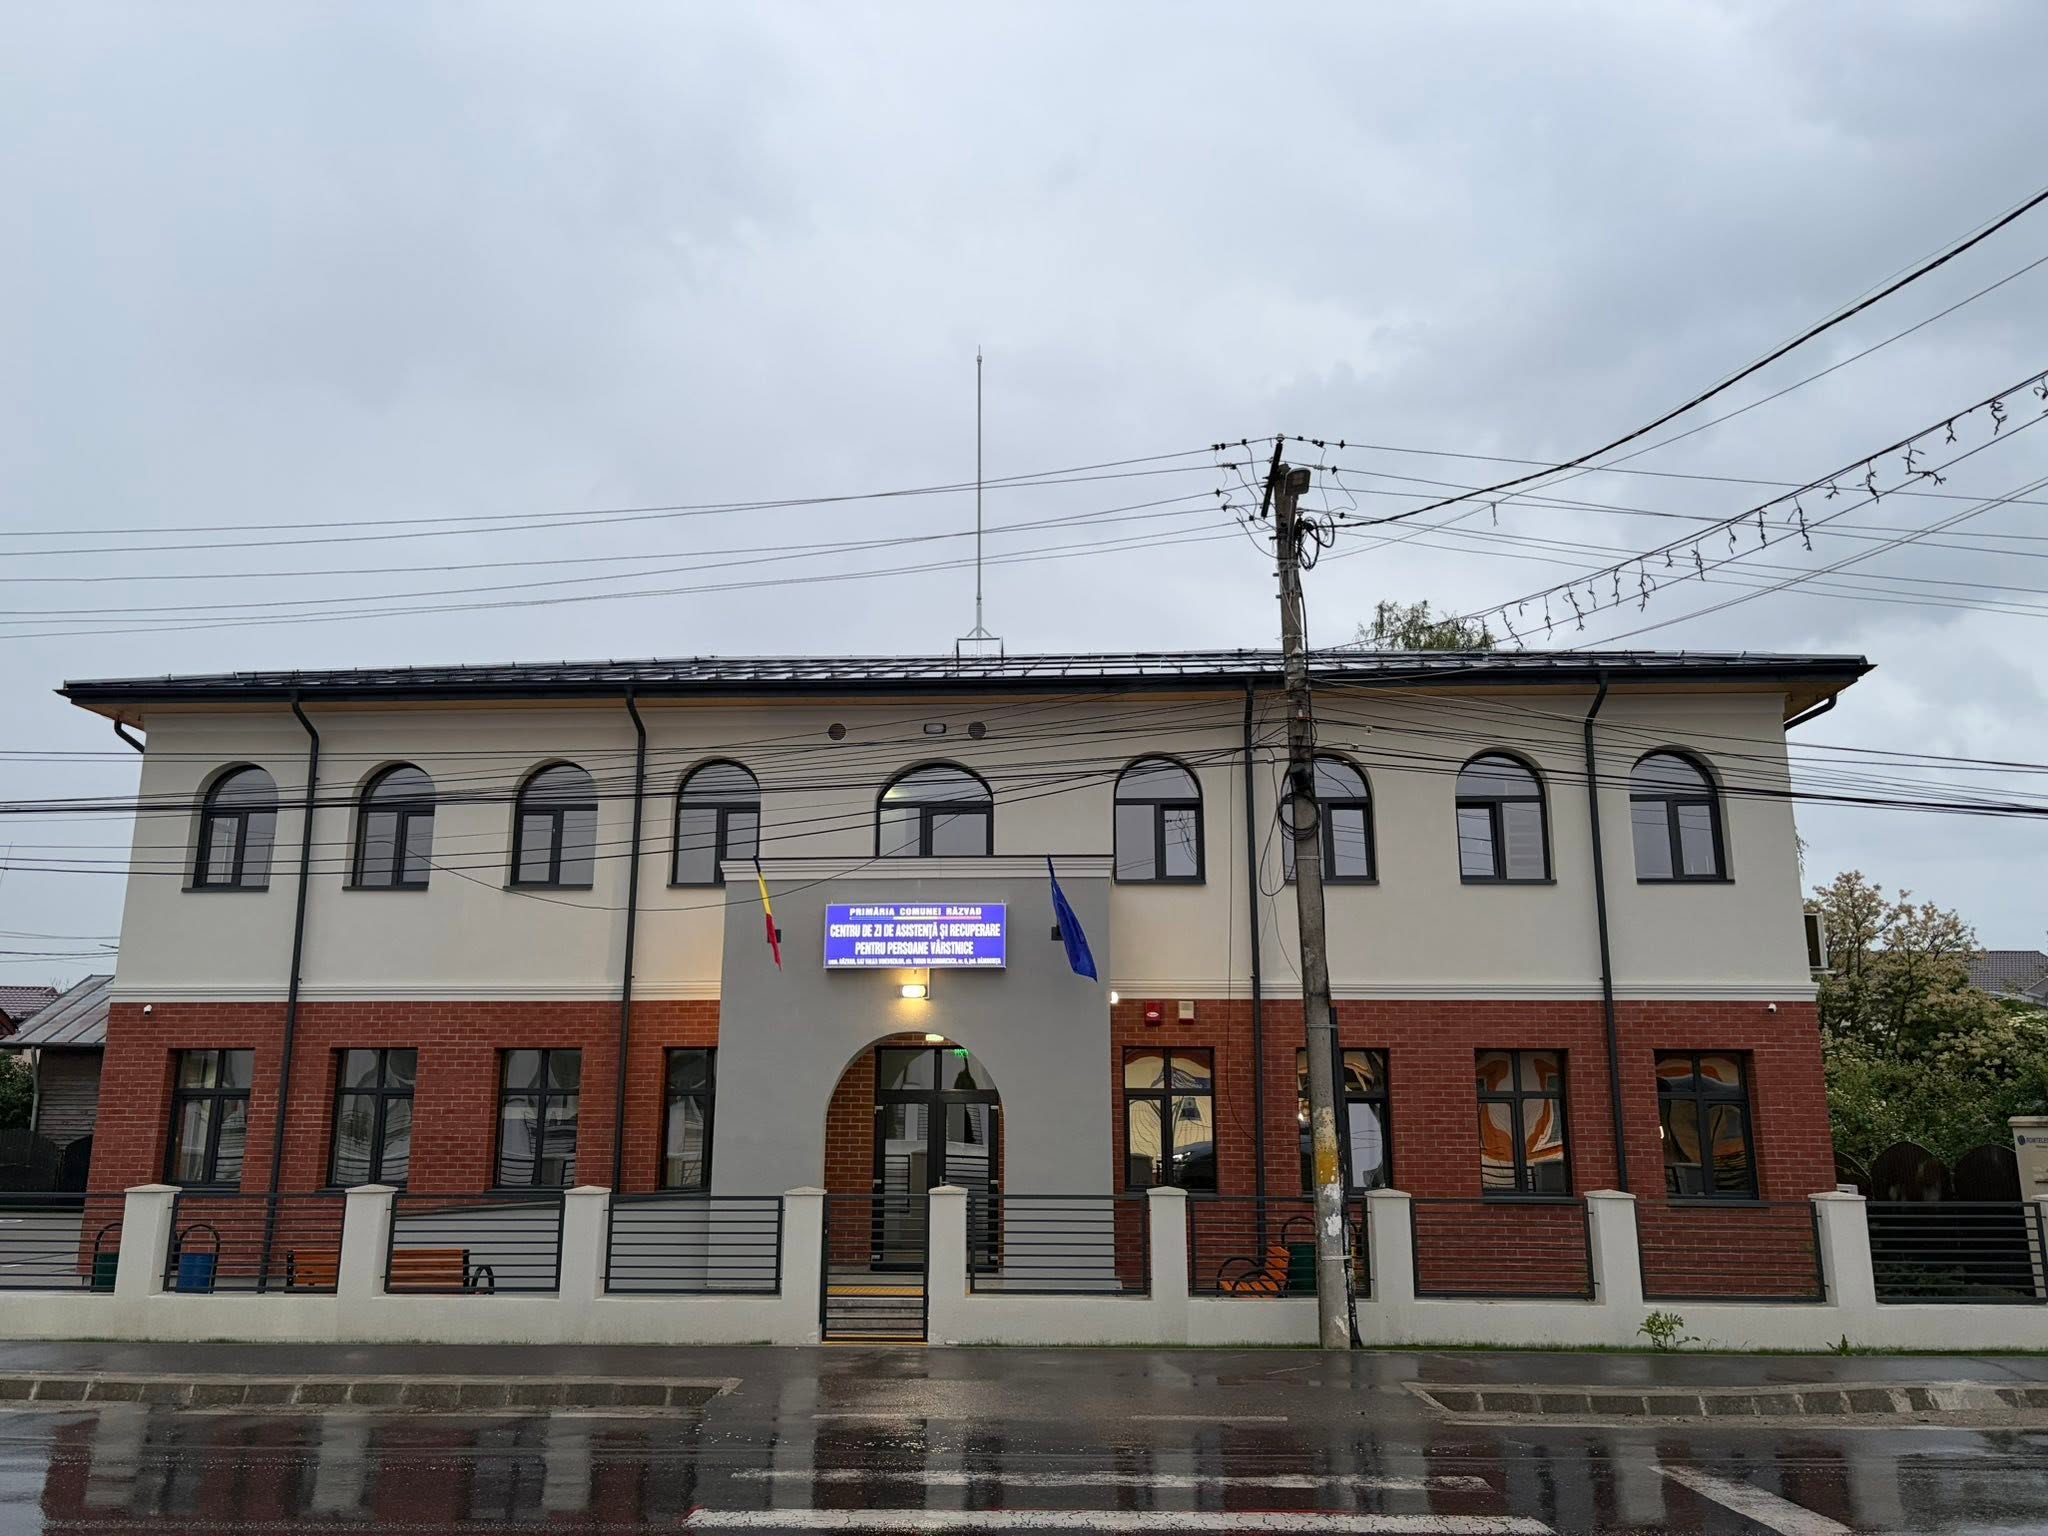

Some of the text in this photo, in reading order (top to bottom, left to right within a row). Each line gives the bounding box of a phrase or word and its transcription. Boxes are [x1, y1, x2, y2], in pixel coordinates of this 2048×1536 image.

[849, 906, 982, 916] PRIMĂRIA COMUNEI RĂZVAD
[830, 924, 861, 938] CENTRU
[861, 924, 873, 937] DE
[873, 924, 882, 937] ZI
[883, 924, 895, 937] DE
[949, 923, 1001, 937] RECUPERARE
[855, 941, 886, 955] PENTRU
[887, 941, 929, 955] PERSOANE
